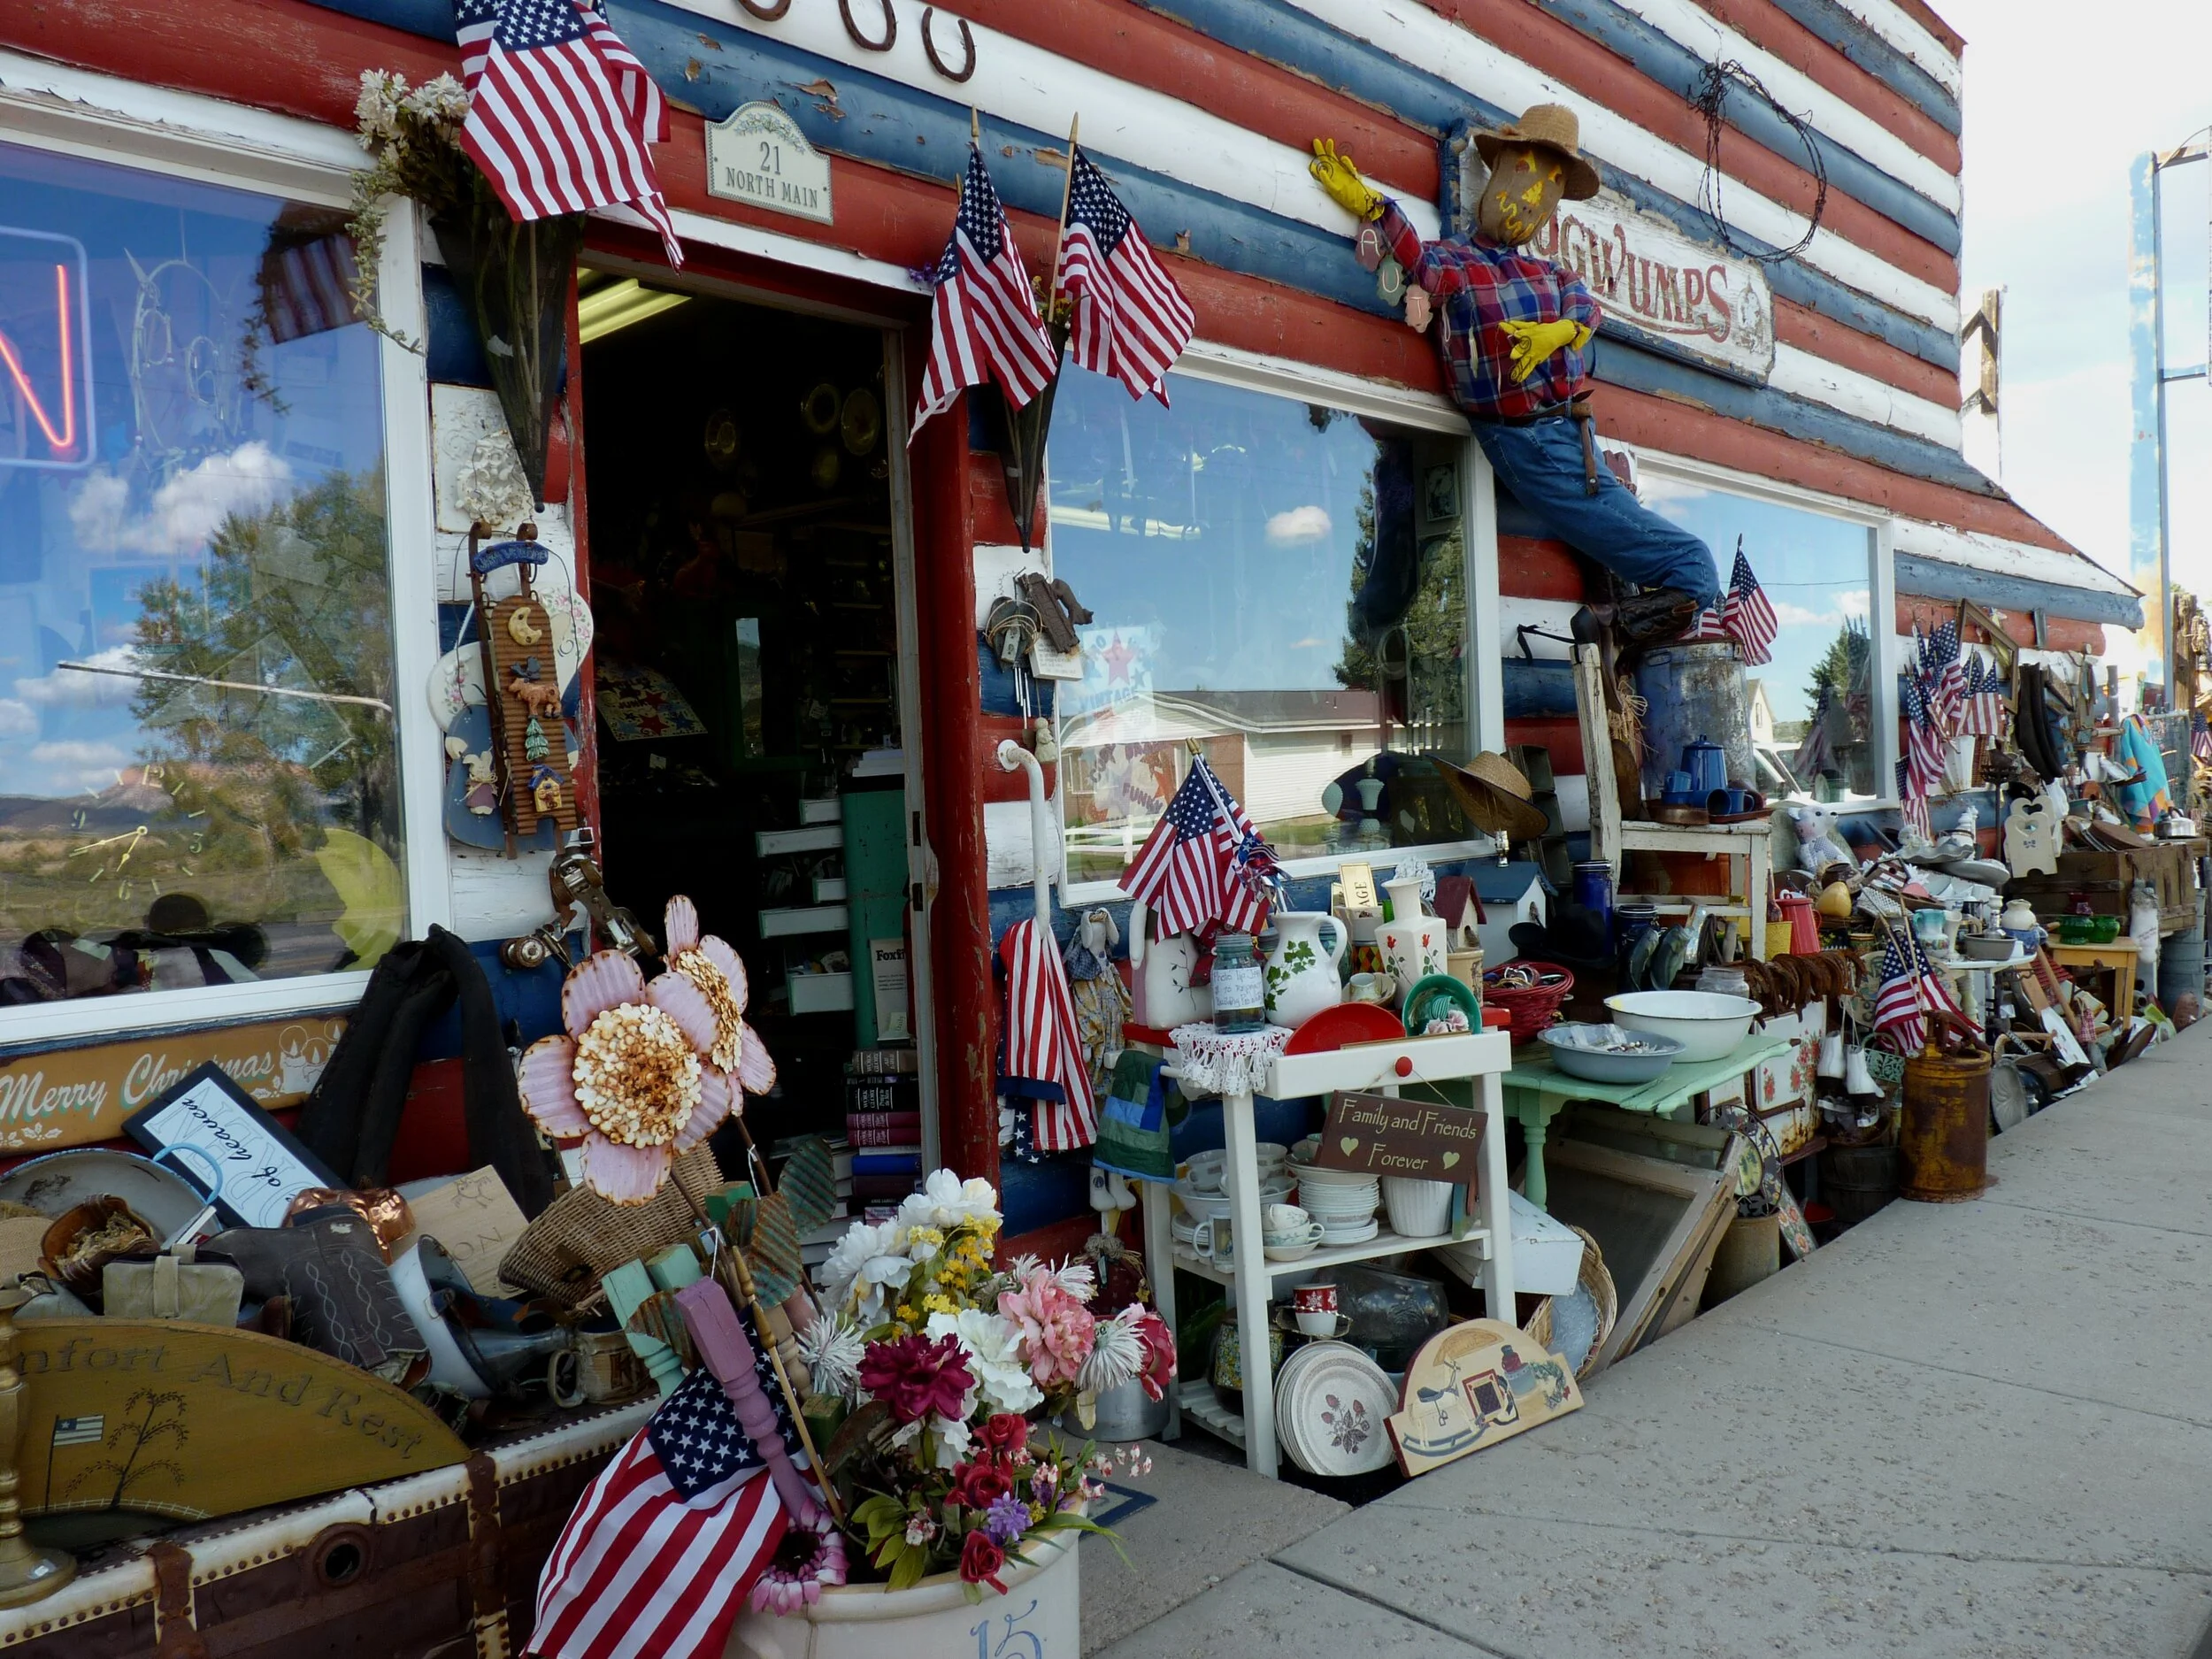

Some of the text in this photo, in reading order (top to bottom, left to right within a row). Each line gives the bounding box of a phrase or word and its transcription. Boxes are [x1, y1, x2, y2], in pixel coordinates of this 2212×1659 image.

[759, 141, 781, 176] 21
[726, 166, 818, 209] NORTH MAIN
[1123, 782, 1164, 815] FUNKY
[0, 1071, 107, 1120] Merry
[181, 1097, 253, 1161] heaven
[1339, 1098, 1478, 1140] Family and Friends
[1367, 1142, 1430, 1171] Forever
[188, 1353, 312, 1407] And
[316, 1385, 422, 1458] Rest
